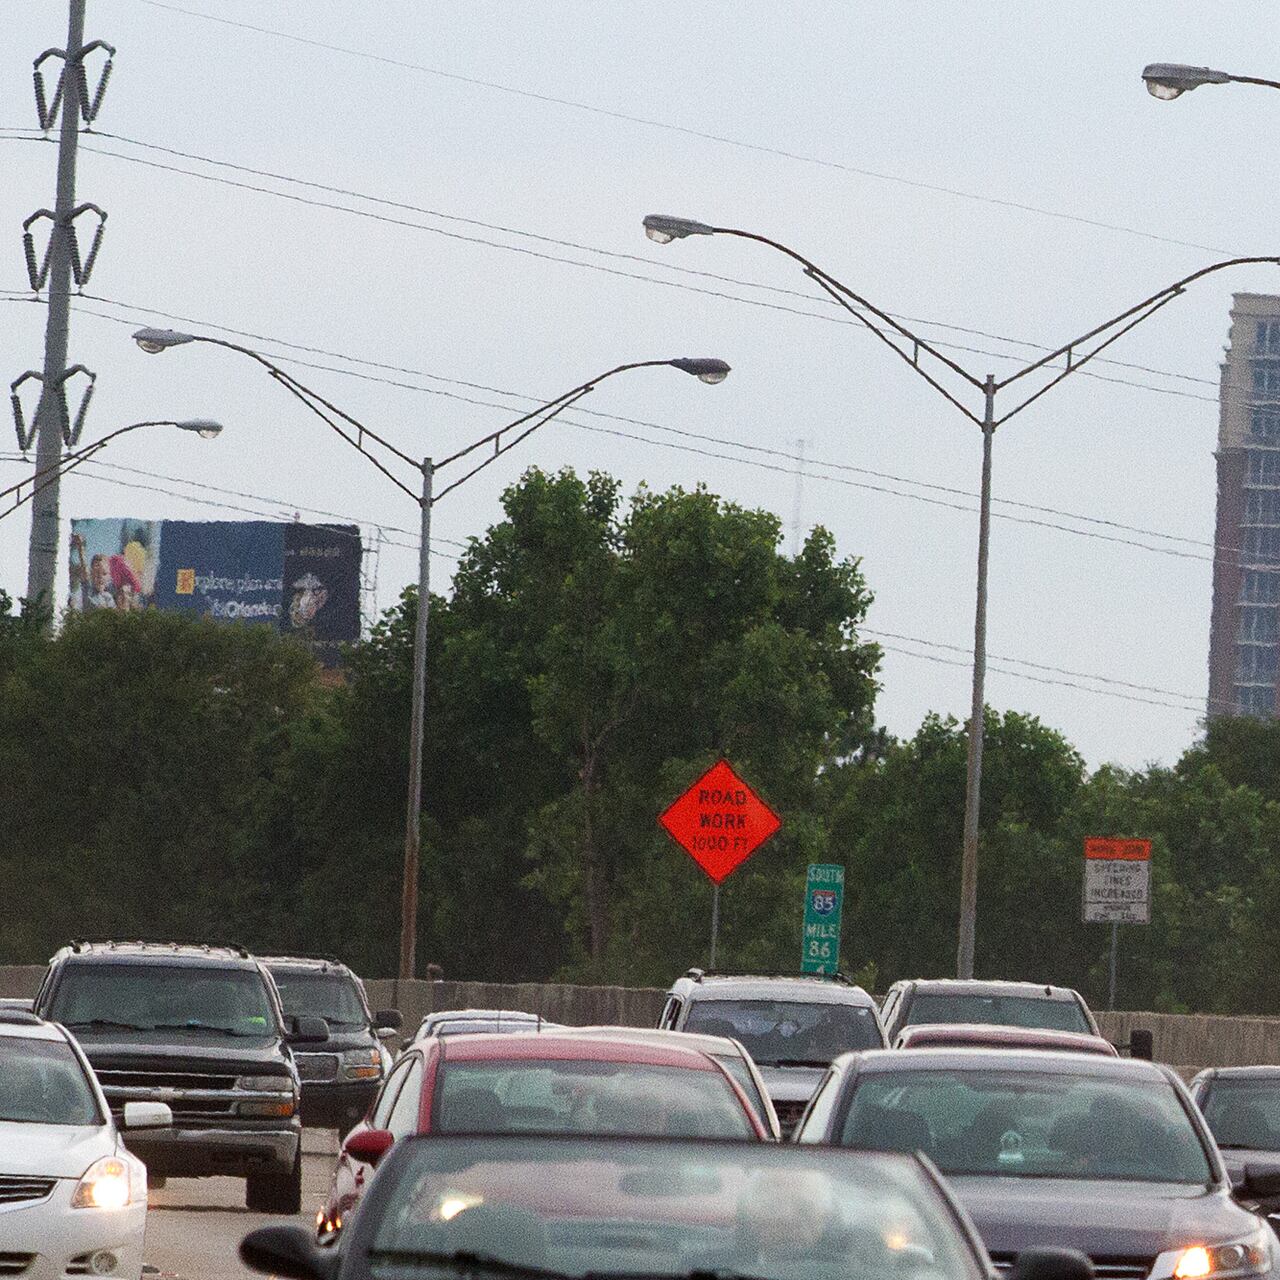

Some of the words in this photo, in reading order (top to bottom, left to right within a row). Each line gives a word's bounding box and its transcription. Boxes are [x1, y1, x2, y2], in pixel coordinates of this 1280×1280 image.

[699, 789, 747, 807] ROAD
[700, 813, 748, 829] WORK
[692, 835, 727, 851] 1000
[733, 836, 748, 850] FT
[808, 867, 845, 882] SOUTH
[814, 895, 834, 911] 85
[806, 923, 837, 938] MILE
[809, 940, 831, 957] 86
